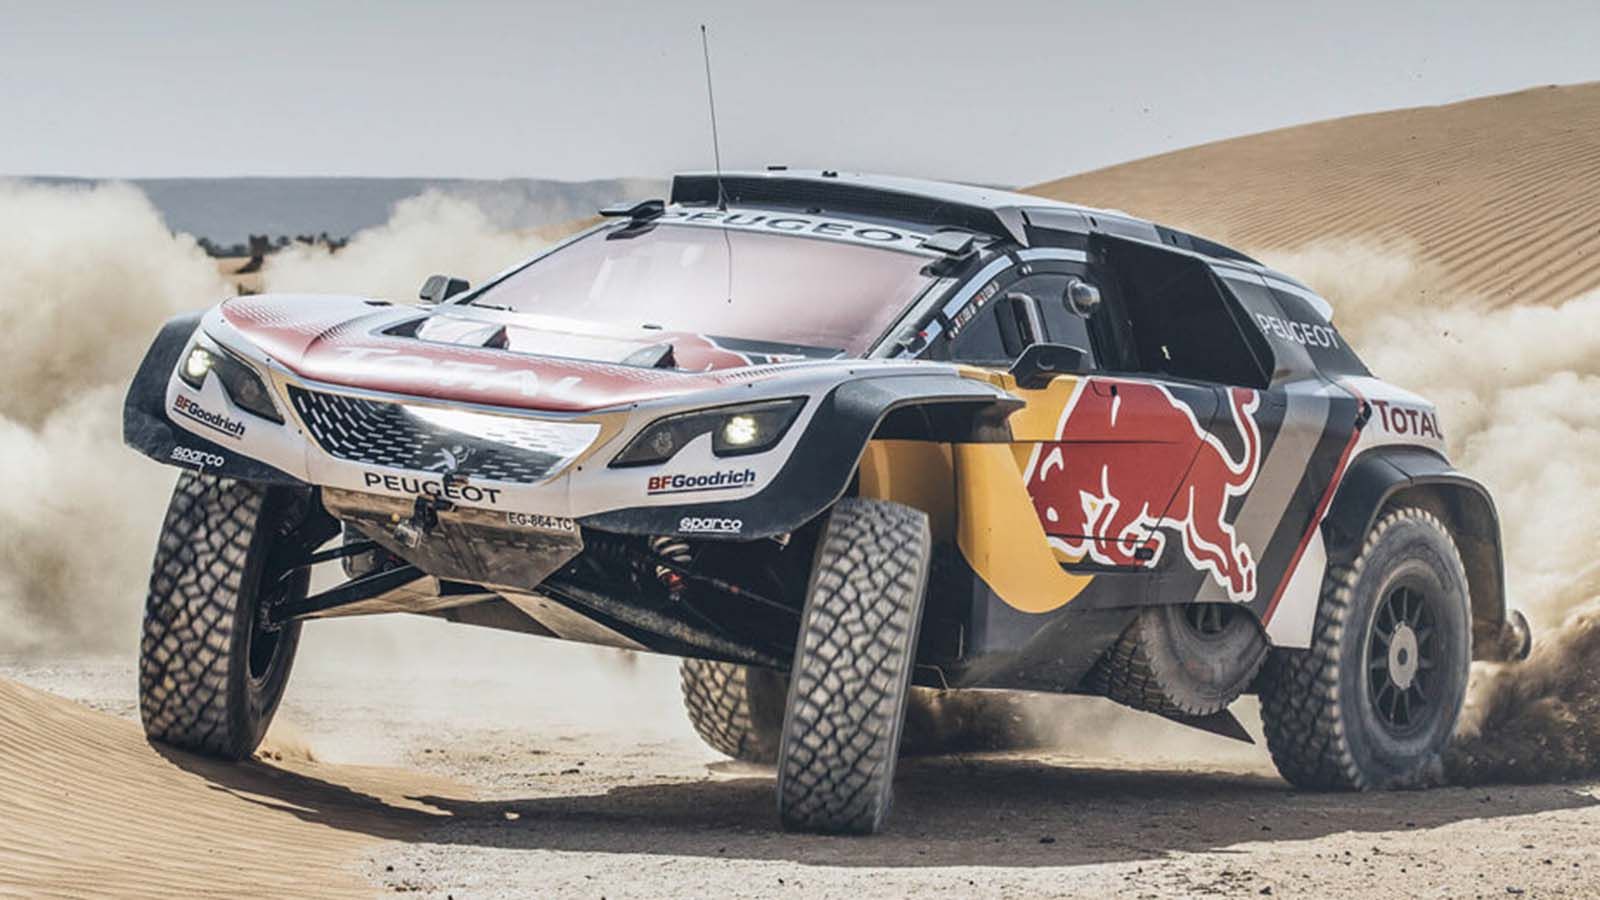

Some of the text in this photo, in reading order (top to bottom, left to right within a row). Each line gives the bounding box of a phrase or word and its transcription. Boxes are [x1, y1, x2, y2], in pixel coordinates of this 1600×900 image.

[1256, 313, 1340, 349] PEUGEOT
[174, 394, 246, 436] BFGoodrich
[1371, 400, 1444, 440] TOTAL
[172, 446, 225, 467] sparco
[364, 472, 502, 504] PEUGEOT
[647, 468, 756, 491] BFGoodrich
[508, 512, 574, 532] EG-864-TC
[679, 517, 742, 532] sparco
